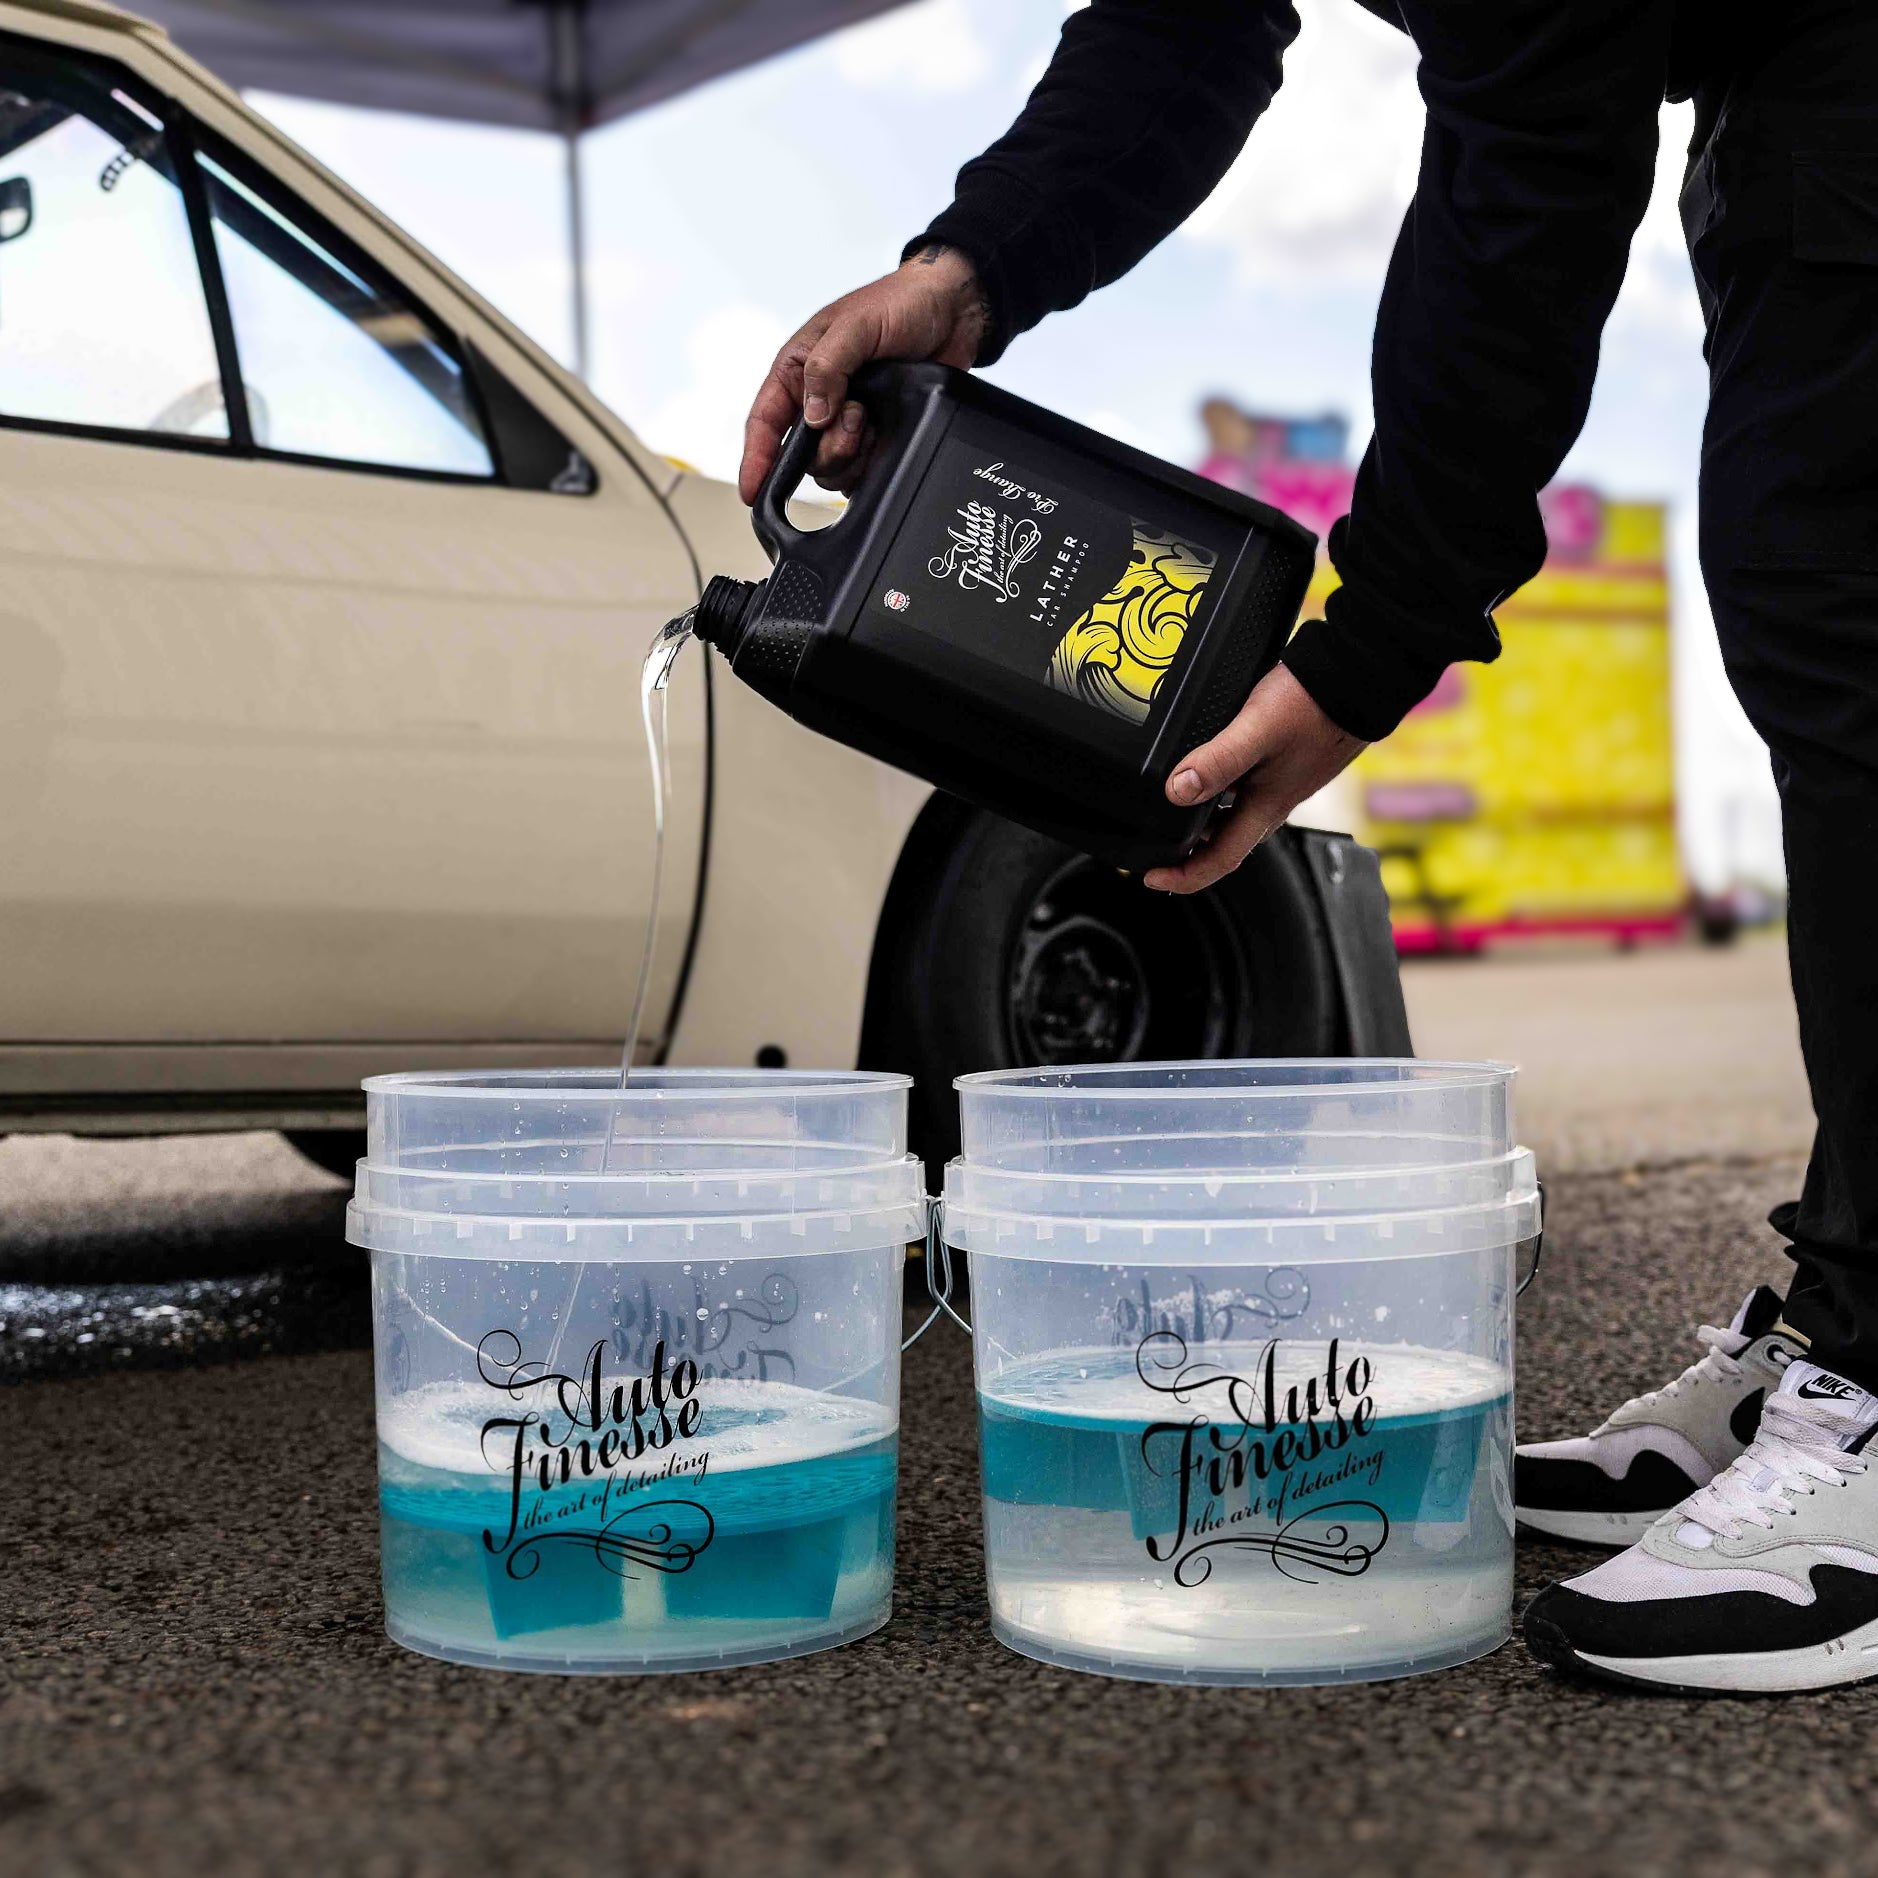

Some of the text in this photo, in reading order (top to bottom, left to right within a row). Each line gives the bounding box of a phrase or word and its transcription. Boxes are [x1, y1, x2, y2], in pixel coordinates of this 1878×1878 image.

[973, 463, 1059, 514] Pro Range
[928, 500, 981, 578] Auto
[958, 506, 1008, 603] Finesse
[1029, 536, 1078, 622] LATHER
[1046, 542, 1089, 627] CAR SHAMPOO
[477, 1329, 703, 1448] Auto
[1136, 1331, 1378, 1450] Auto
[1811, 1374, 1856, 1396] NIKE
[480, 1399, 704, 1554] Finesse
[523, 1452, 709, 1530] the art of detailing
[1141, 1396, 1378, 1562] Finesse
[1193, 1450, 1386, 1536] the art of detailing
